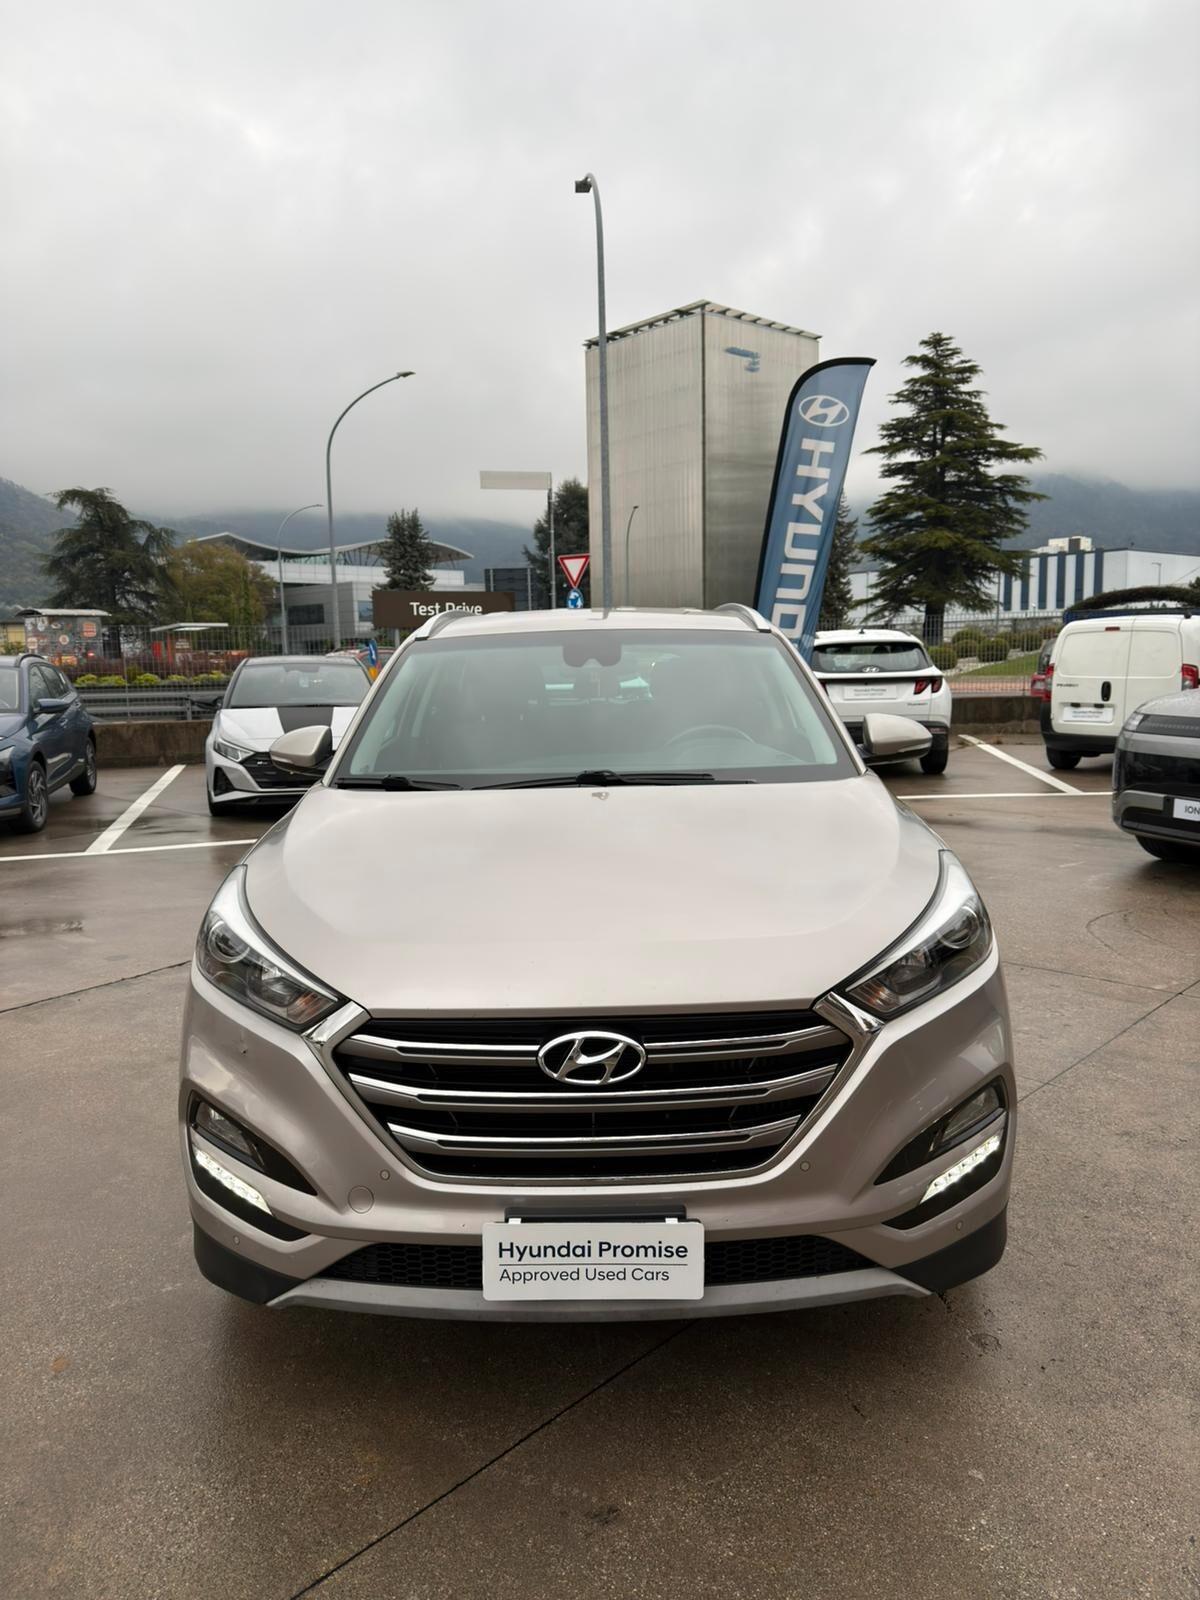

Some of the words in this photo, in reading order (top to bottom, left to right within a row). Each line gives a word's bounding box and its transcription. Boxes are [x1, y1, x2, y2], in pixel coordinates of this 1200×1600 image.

[770, 437, 836, 648] HYUND
[409, 602, 441, 616] Test
[498, 1240, 592, 1261] Hyundai
[598, 1240, 688, 1259] Promise
[499, 1267, 581, 1284] Approved
[585, 1267, 627, 1281] Used
[631, 1267, 670, 1281] Cars
